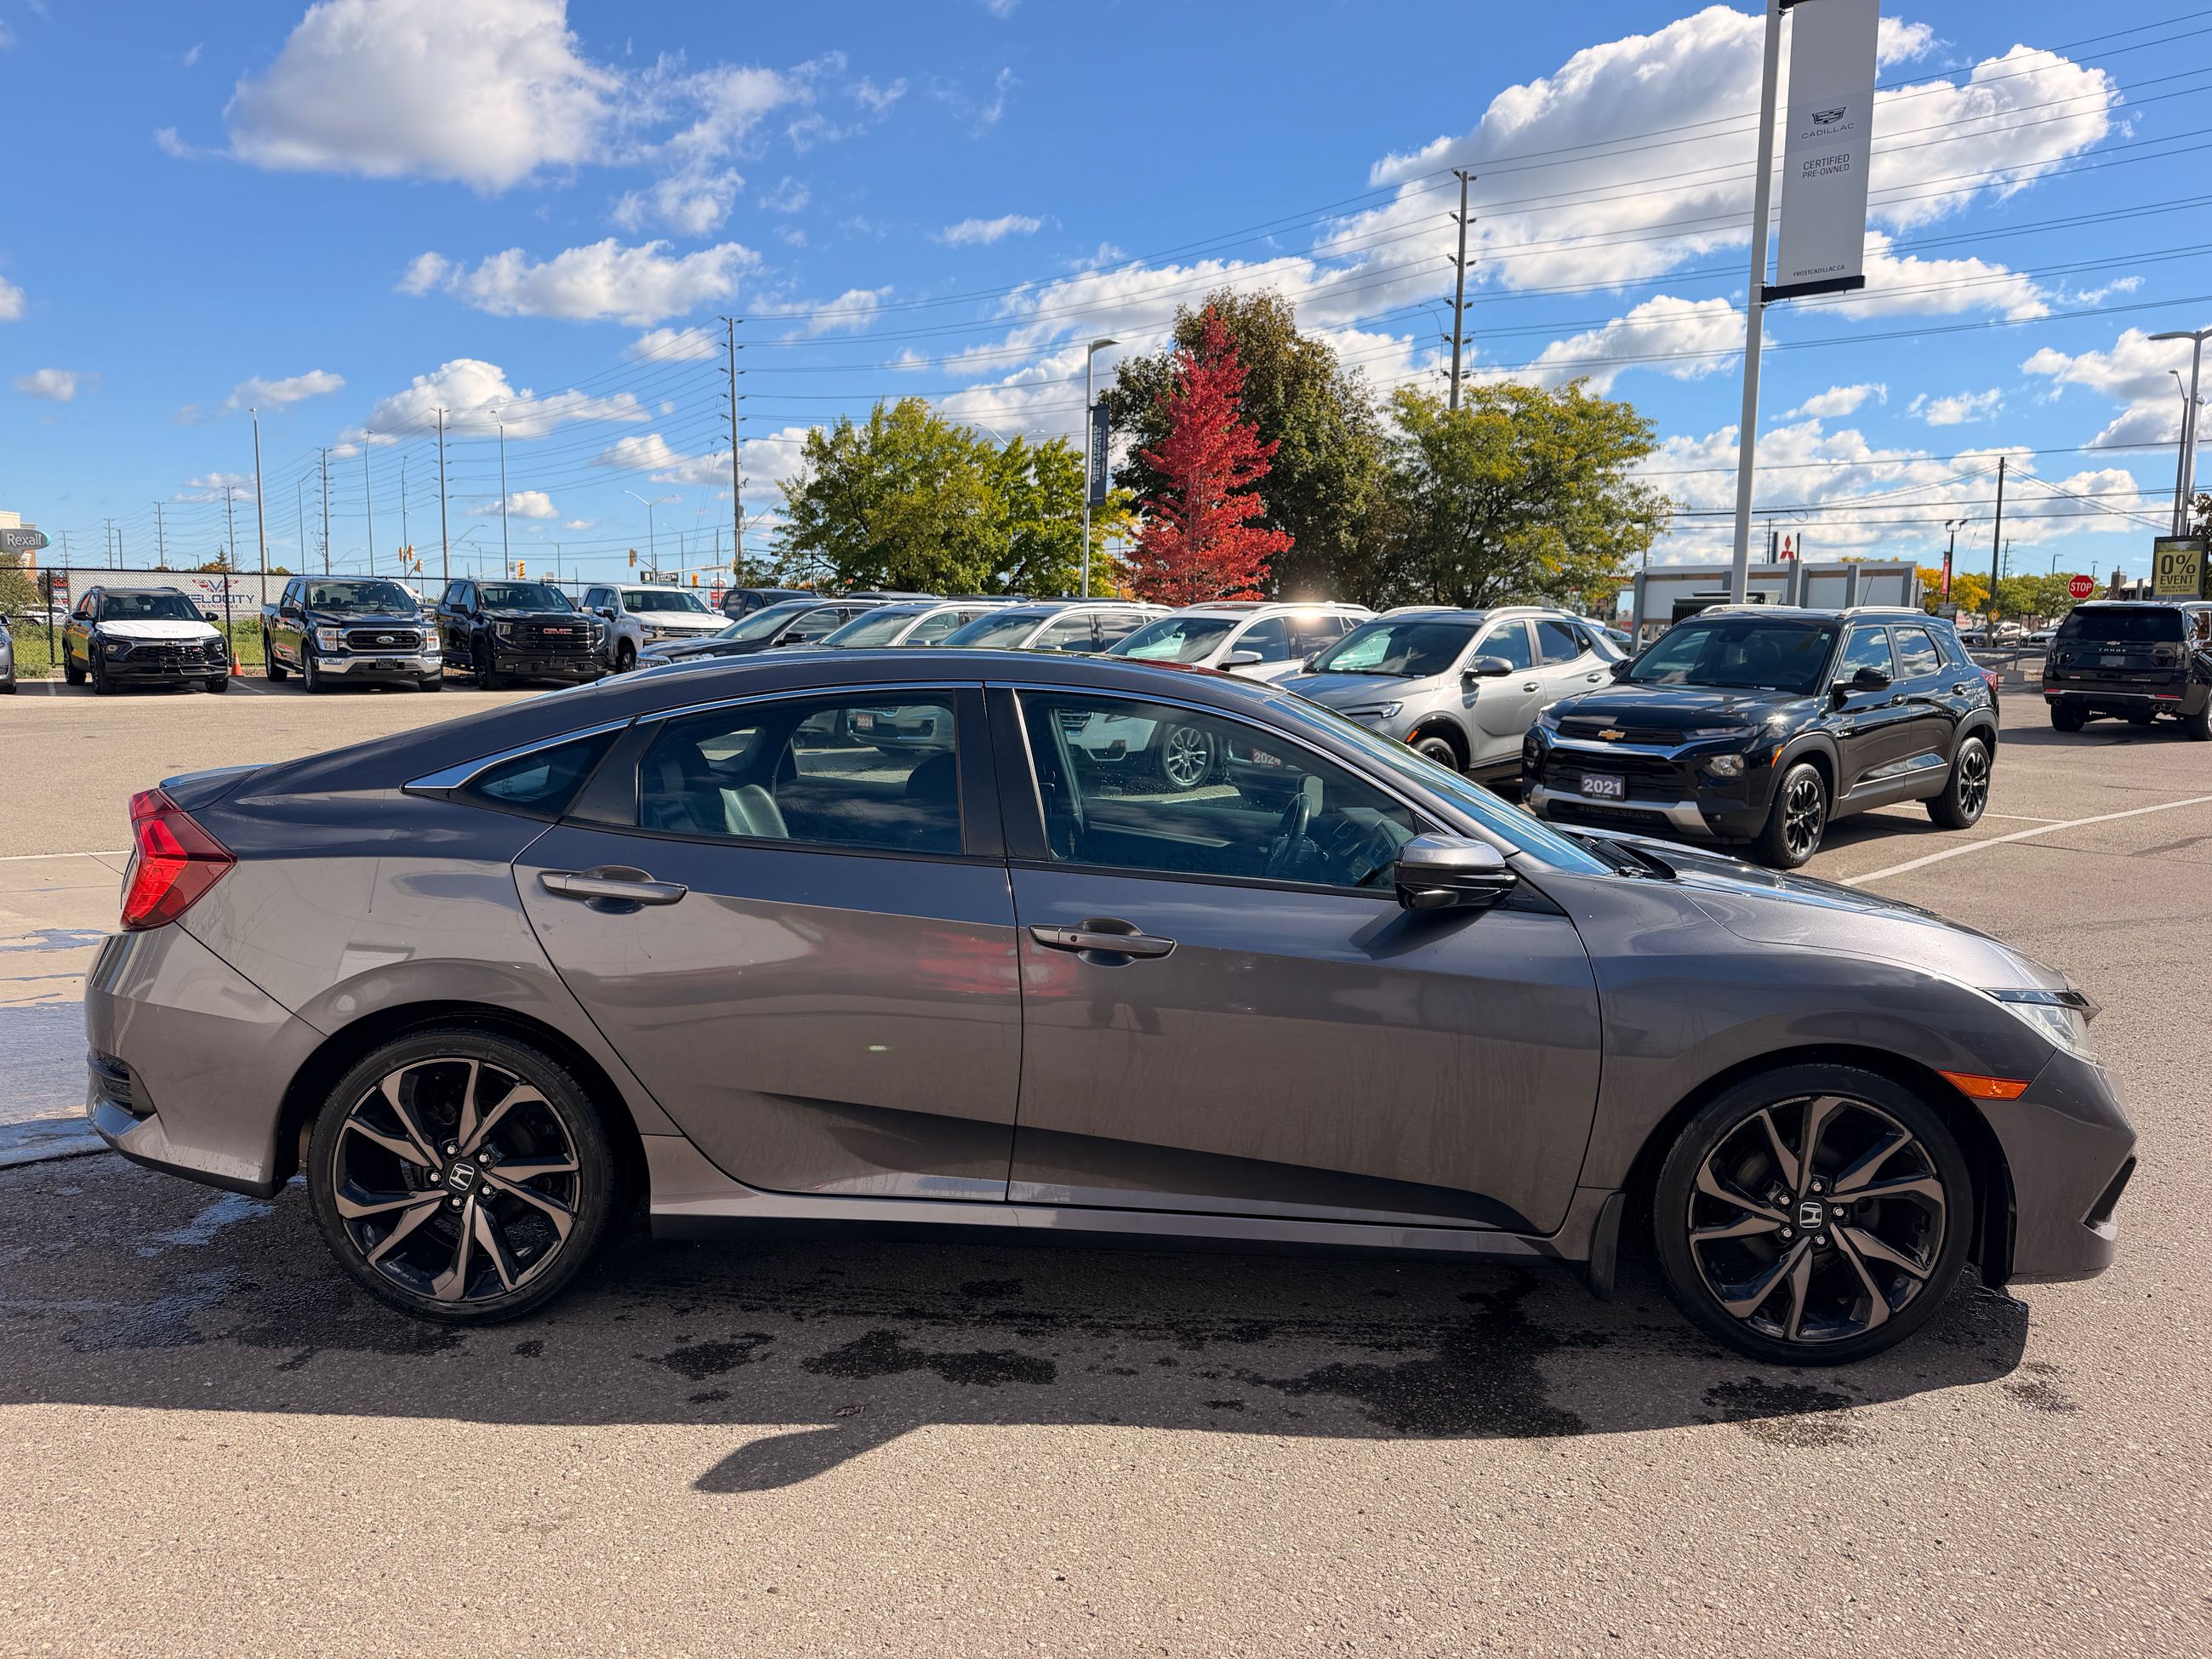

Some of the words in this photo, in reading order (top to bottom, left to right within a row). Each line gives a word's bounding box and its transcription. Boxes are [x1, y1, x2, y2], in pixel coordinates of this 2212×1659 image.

[1801, 123, 1855, 140] CADILLAC
[1803, 153, 1850, 171] CERTIFIED
[1802, 163, 1850, 179] PRE-OWNED
[1793, 265, 1845, 277] FROSTCADILLAC.CA
[7, 533, 42, 547] Rexall
[2161, 553, 2196, 575] 0%
[2160, 574, 2195, 585] EVENT
[2070, 582, 2092, 593] STOP
[188, 594, 254, 604] ELOCITY
[858, 717, 873, 728] 2024
[1583, 778, 1621, 795] 2021
